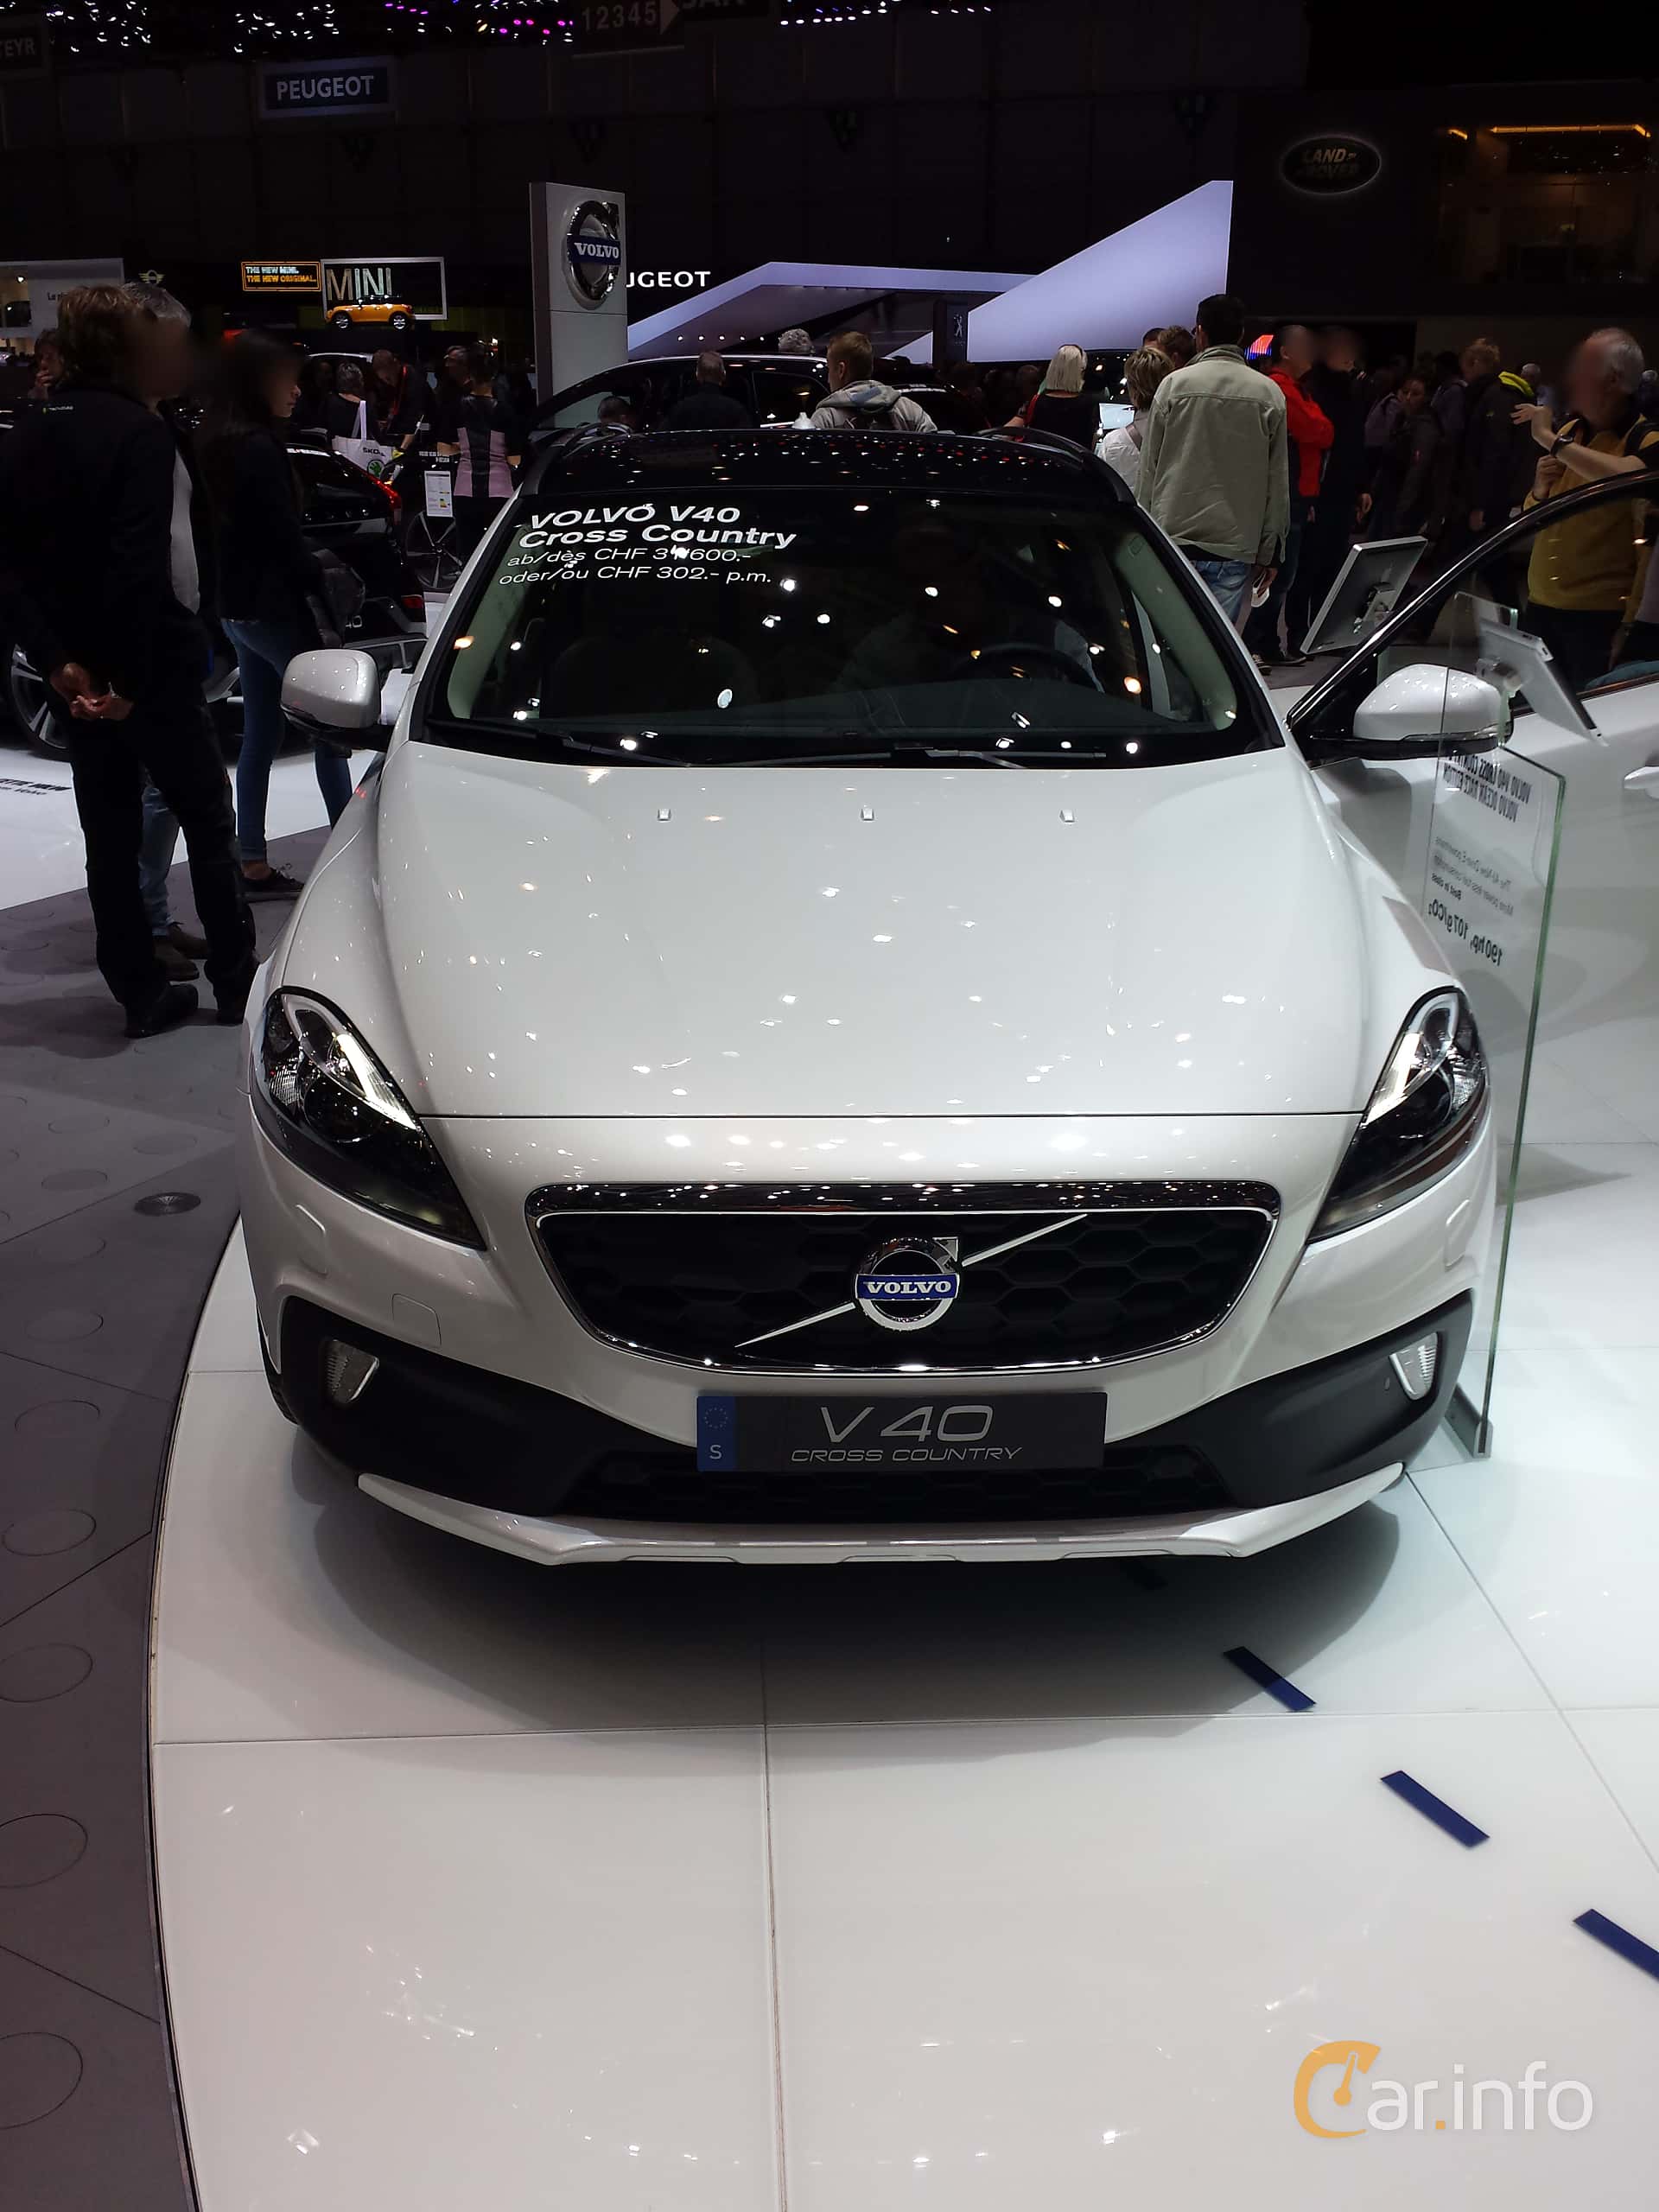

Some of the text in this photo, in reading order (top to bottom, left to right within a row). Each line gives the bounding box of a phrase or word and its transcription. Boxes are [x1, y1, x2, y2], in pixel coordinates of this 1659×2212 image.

[582, 5, 658, 35] 12345
[276, 75, 374, 101] PEUGEOT
[574, 242, 620, 259] VOLVO
[325, 267, 393, 301] MINI
[531, 505, 741, 530] VOLVO V40
[518, 524, 797, 550] Cross Country
[507, 550, 587, 567] ab/dès
[594, 548, 648, 560] CHF
[499, 566, 772, 585] oder/ou CHF 302.- p.m.
[863, 1281, 951, 1294] VOLVO
[709, 1444, 722, 1459] S
[791, 1446, 1023, 1463] CROSS COUNTRY
